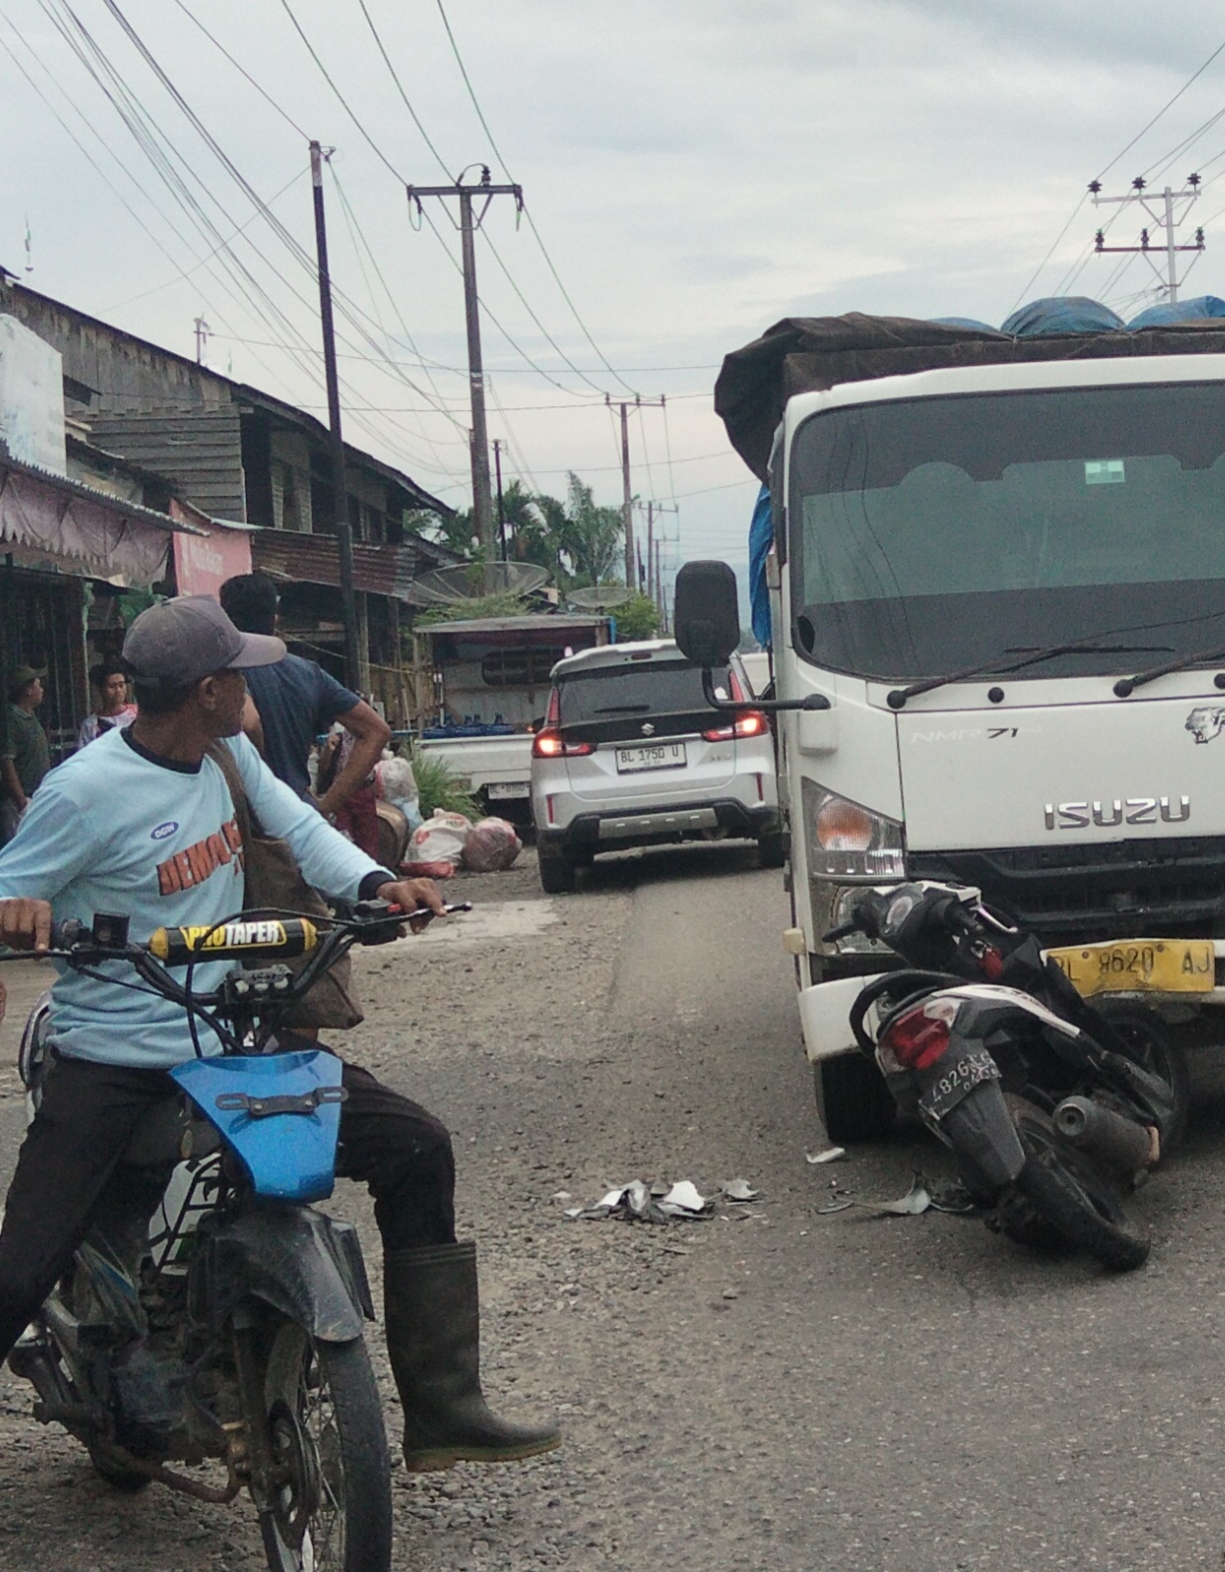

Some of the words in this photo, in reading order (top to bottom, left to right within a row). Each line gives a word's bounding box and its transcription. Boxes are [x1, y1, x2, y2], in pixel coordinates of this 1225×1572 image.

[986, 727, 1019, 739] 71
[620, 751, 635, 763] BL
[671, 745, 679, 757] U
[1045, 795, 1190, 831] ISUZU
[154, 823, 176, 839] DGW
[1181, 947, 1210, 975] AJ
